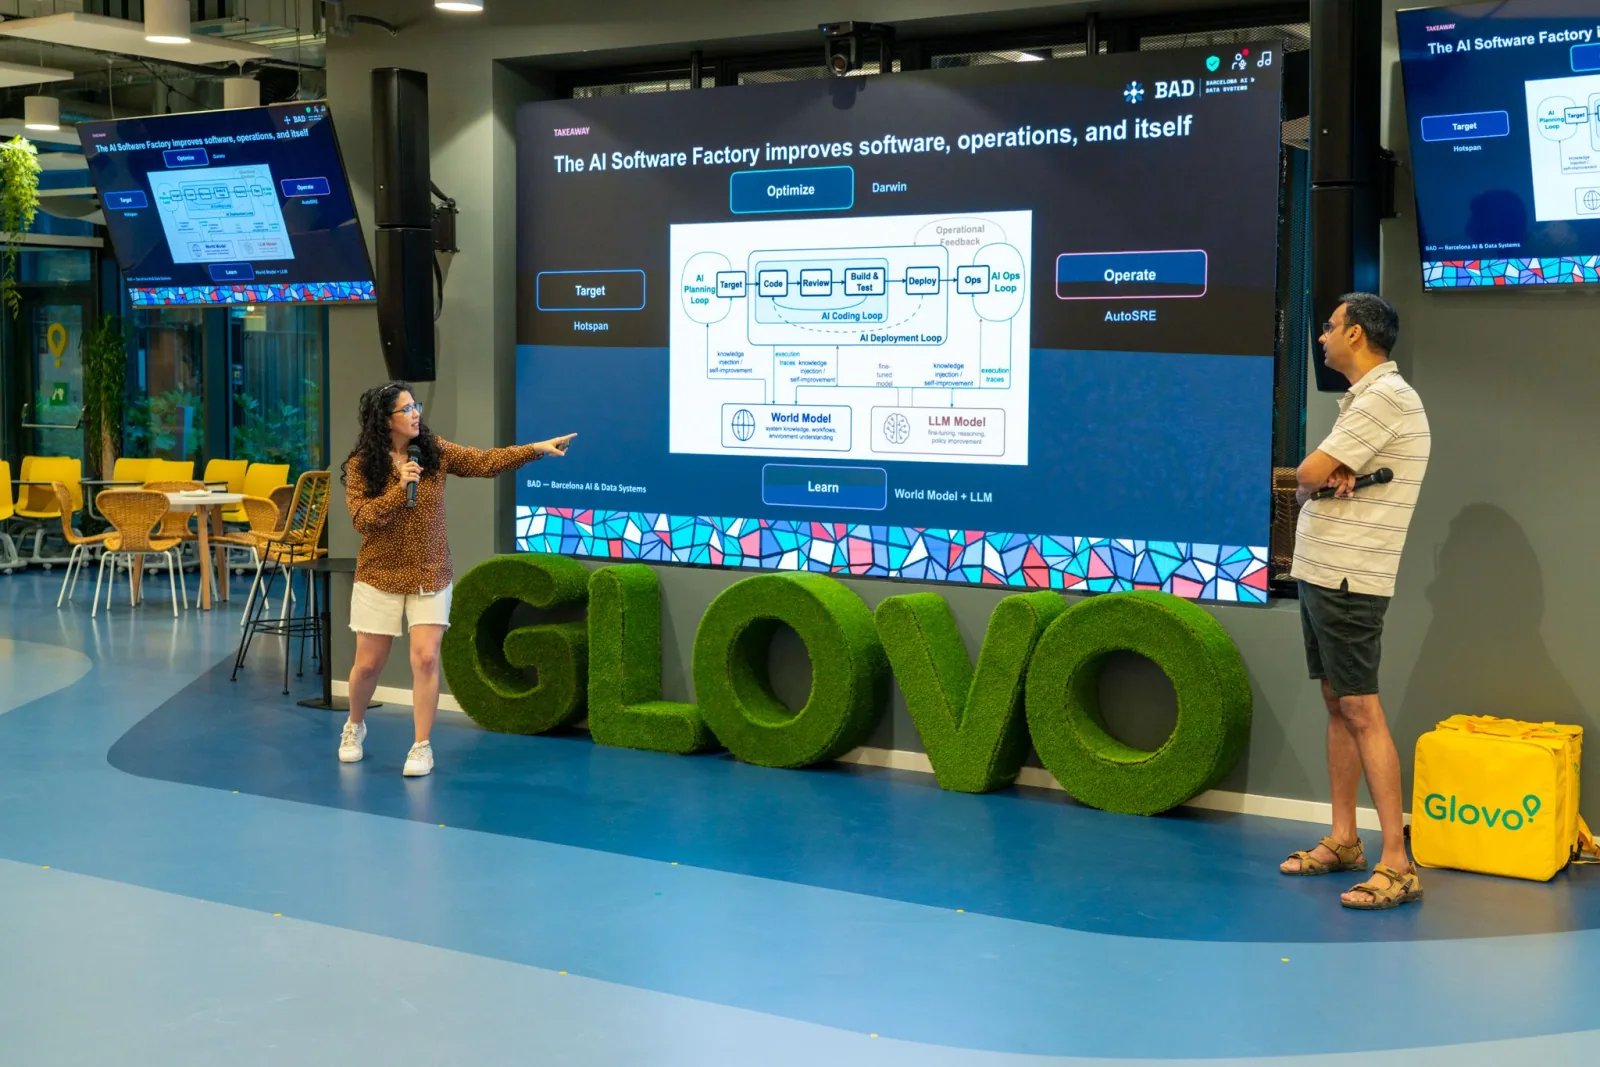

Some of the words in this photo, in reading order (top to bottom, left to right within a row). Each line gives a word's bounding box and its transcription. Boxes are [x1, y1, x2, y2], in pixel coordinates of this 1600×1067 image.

[1426, 24, 1456, 32] TAKEAWAY
[1428, 43, 1452, 54] The
[1456, 40, 1470, 52] AI
[1475, 36, 1535, 50] Software
[1539, 28, 1592, 43] Factory
[1155, 80, 1194, 98] BAD
[554, 127, 590, 137] TAKEAWAY
[1452, 122, 1477, 131] Target
[96, 144, 108, 153] The
[118, 142, 145, 151] Software
[146, 140, 171, 149] Factory
[172, 138, 203, 148] improves
[204, 136, 235, 144] software,
[236, 132, 276, 143] operations,
[276, 130, 290, 138] and
[291, 128, 308, 138] itself
[554, 154, 584, 173] The
[589, 152, 606, 171] AI
[611, 149, 687, 170] Software
[692, 144, 760, 167] Factory
[766, 138, 853, 164] improves
[859, 134, 950, 155] software,
[958, 125, 1078, 154] operations,
[1085, 119, 1127, 142] and
[1134, 114, 1193, 139] itself
[767, 183, 815, 198] Optimize
[872, 181, 907, 193] Darwin
[936, 225, 985, 235] Operational
[909, 277, 936, 286] Deploy
[965, 276, 981, 285] Ops
[1003, 272, 1020, 281] Ops
[1104, 268, 1156, 284] Operate
[684, 286, 715, 294] Planning
[720, 281, 742, 290] Target
[995, 284, 1017, 293] Loop
[575, 285, 606, 298] Target
[832, 312, 860, 321] Coding
[862, 312, 882, 320] Loop
[1104, 310, 1156, 321] AutoSRE
[574, 321, 608, 332] Hotspan
[871, 334, 918, 344] Deployment
[921, 334, 942, 343] Loop
[771, 413, 799, 422] World
[802, 413, 831, 423] Model
[929, 416, 950, 426] LLM
[954, 417, 986, 427] Model
[551, 481, 584, 490] Barcelona
[618, 484, 646, 493] Systems
[808, 481, 839, 493] Learn
[894, 488, 924, 500] World
[927, 490, 957, 501] Model
[970, 492, 992, 502] LLM
[442, 554, 1252, 816] GLOVO
[1425, 794, 1523, 830] Glovo
